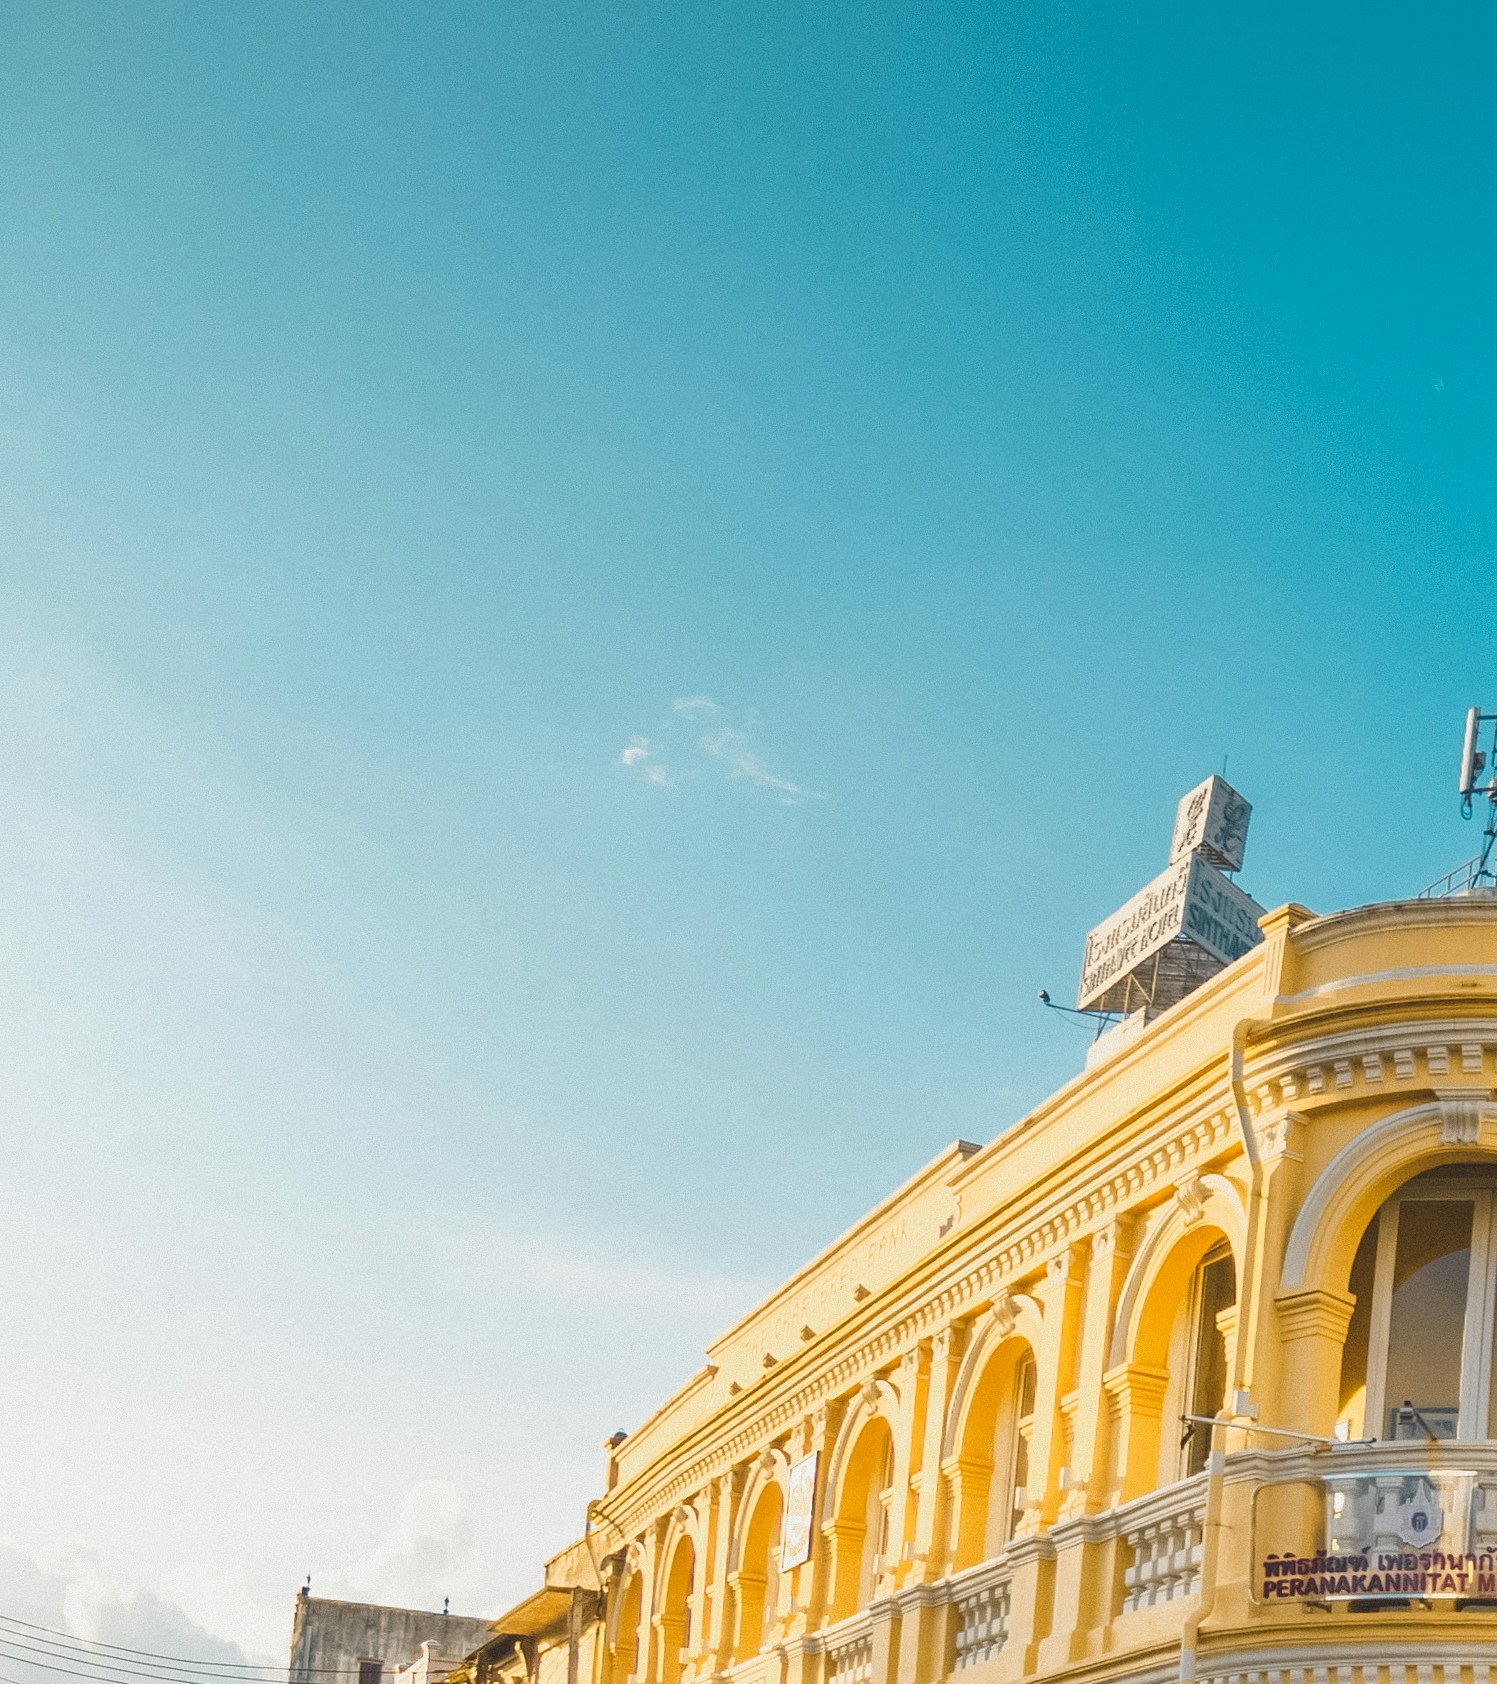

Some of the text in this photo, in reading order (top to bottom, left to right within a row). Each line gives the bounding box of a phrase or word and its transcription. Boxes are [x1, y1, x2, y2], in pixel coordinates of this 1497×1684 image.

[1141, 904, 1180, 952] HOTEL
[1262, 1546, 1372, 1578] พิพิธภัณฑ์
[1262, 1572, 1469, 1599] PERANAKANNITAT
